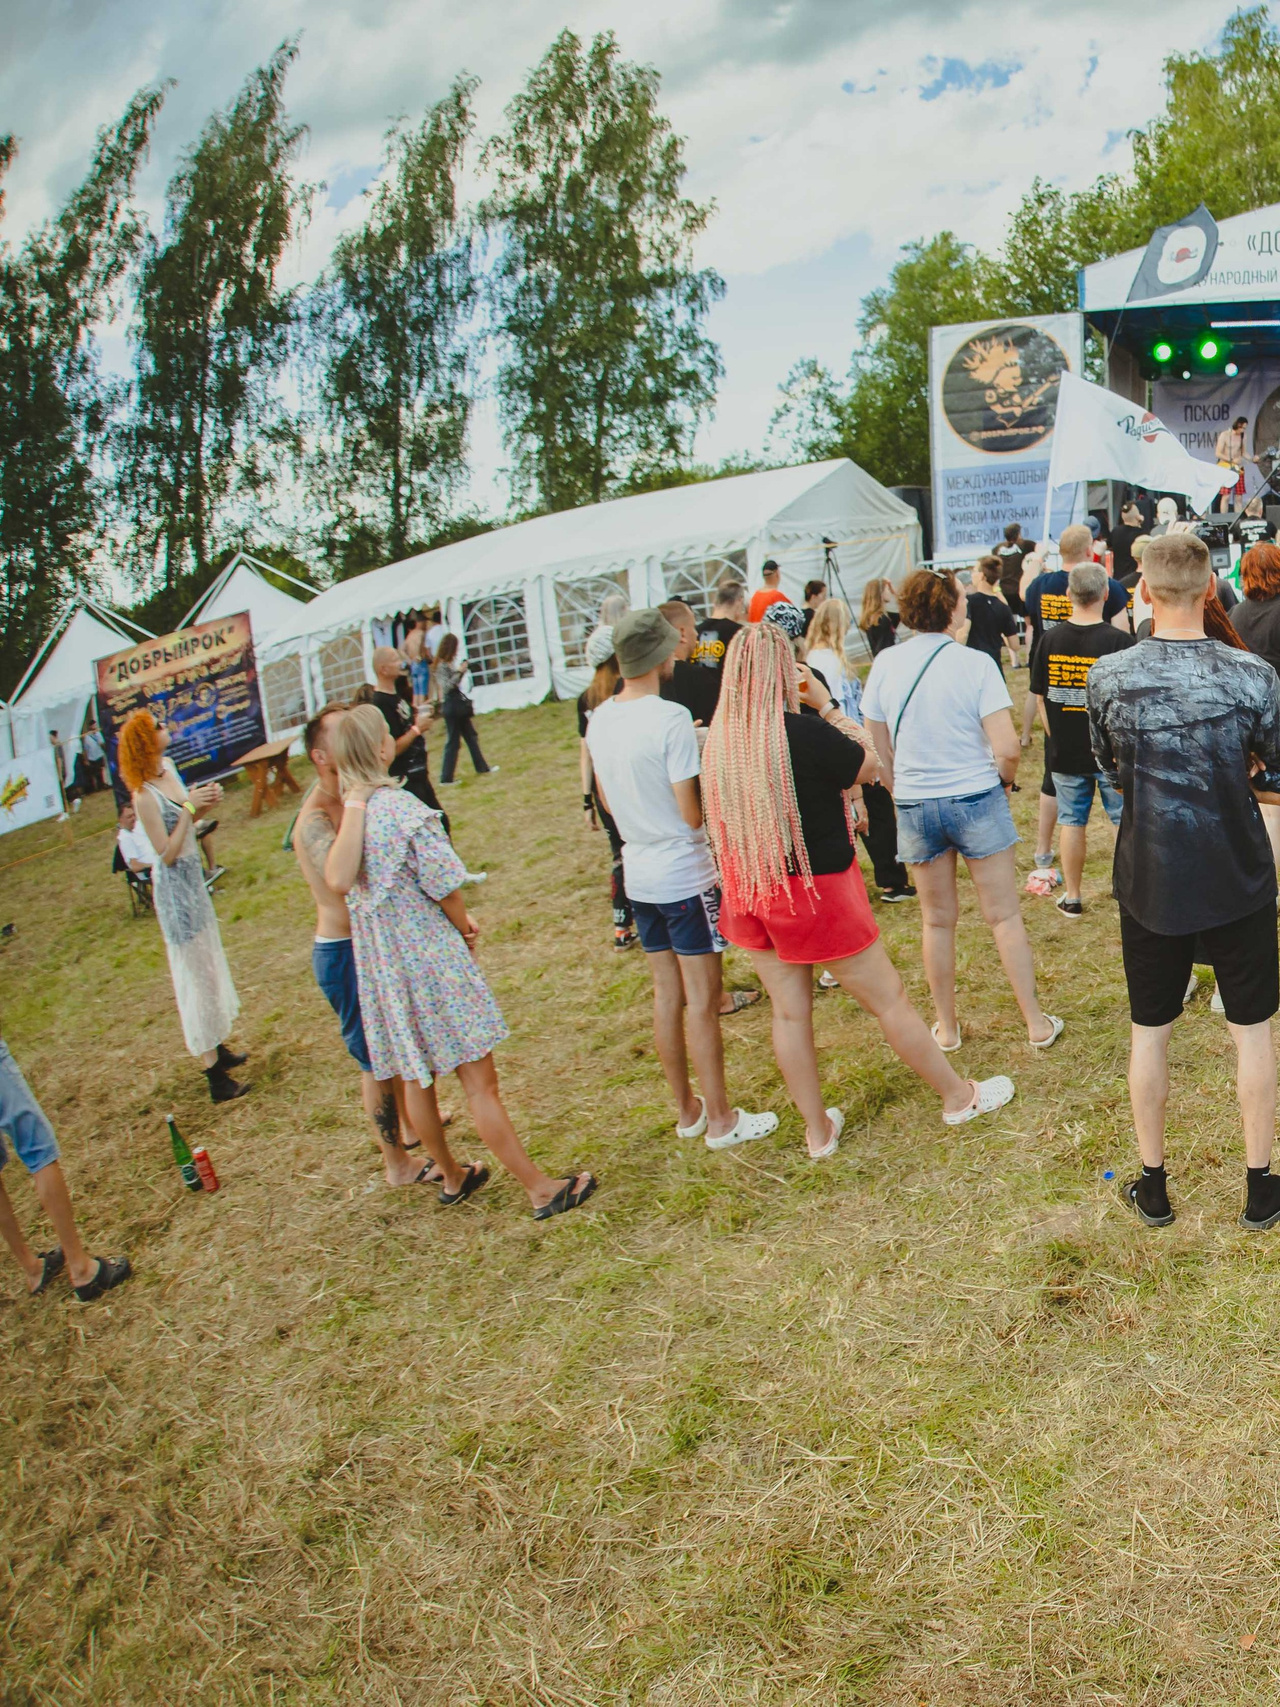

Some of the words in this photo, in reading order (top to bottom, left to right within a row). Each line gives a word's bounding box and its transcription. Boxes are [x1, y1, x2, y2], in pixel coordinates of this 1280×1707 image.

[1203, 267, 1278, 286] НАРОДНЫЙ
[1184, 403, 1230, 421] ПСКОВ
[1180, 432, 1219, 449] ПРИМ
[946, 490, 1014, 509] ФЕСТИВАЛЬ
[948, 510, 988, 527] ЖИВОЙ
[991, 506, 1040, 523] МУЗЫКИ
